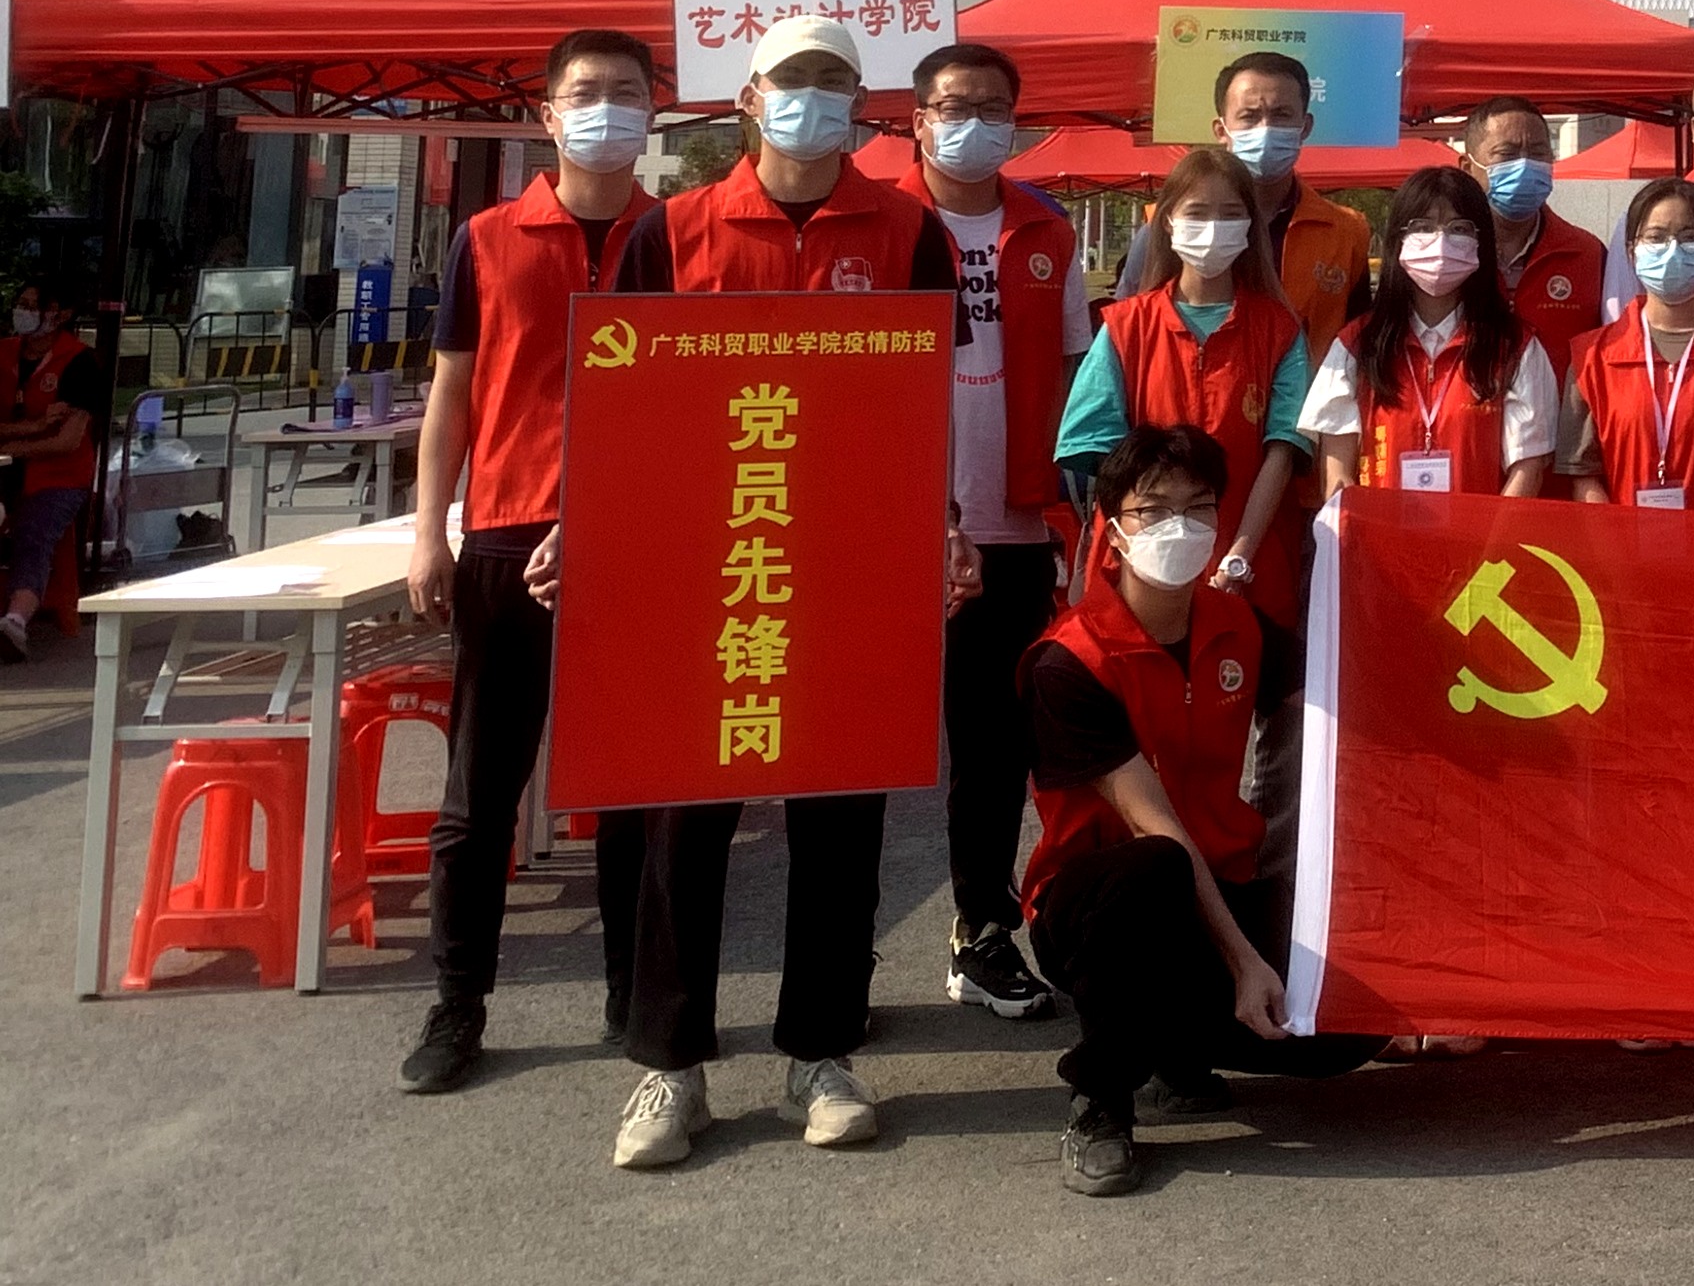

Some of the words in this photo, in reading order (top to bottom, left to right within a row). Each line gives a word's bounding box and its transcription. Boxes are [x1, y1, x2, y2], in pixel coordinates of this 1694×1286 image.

[1206, 28, 1307, 44] 广东科贸职业学院
[649, 329, 936, 357] 广东科贸职业学院疫情防控
[715, 383, 799, 765] 党员先锋岗
